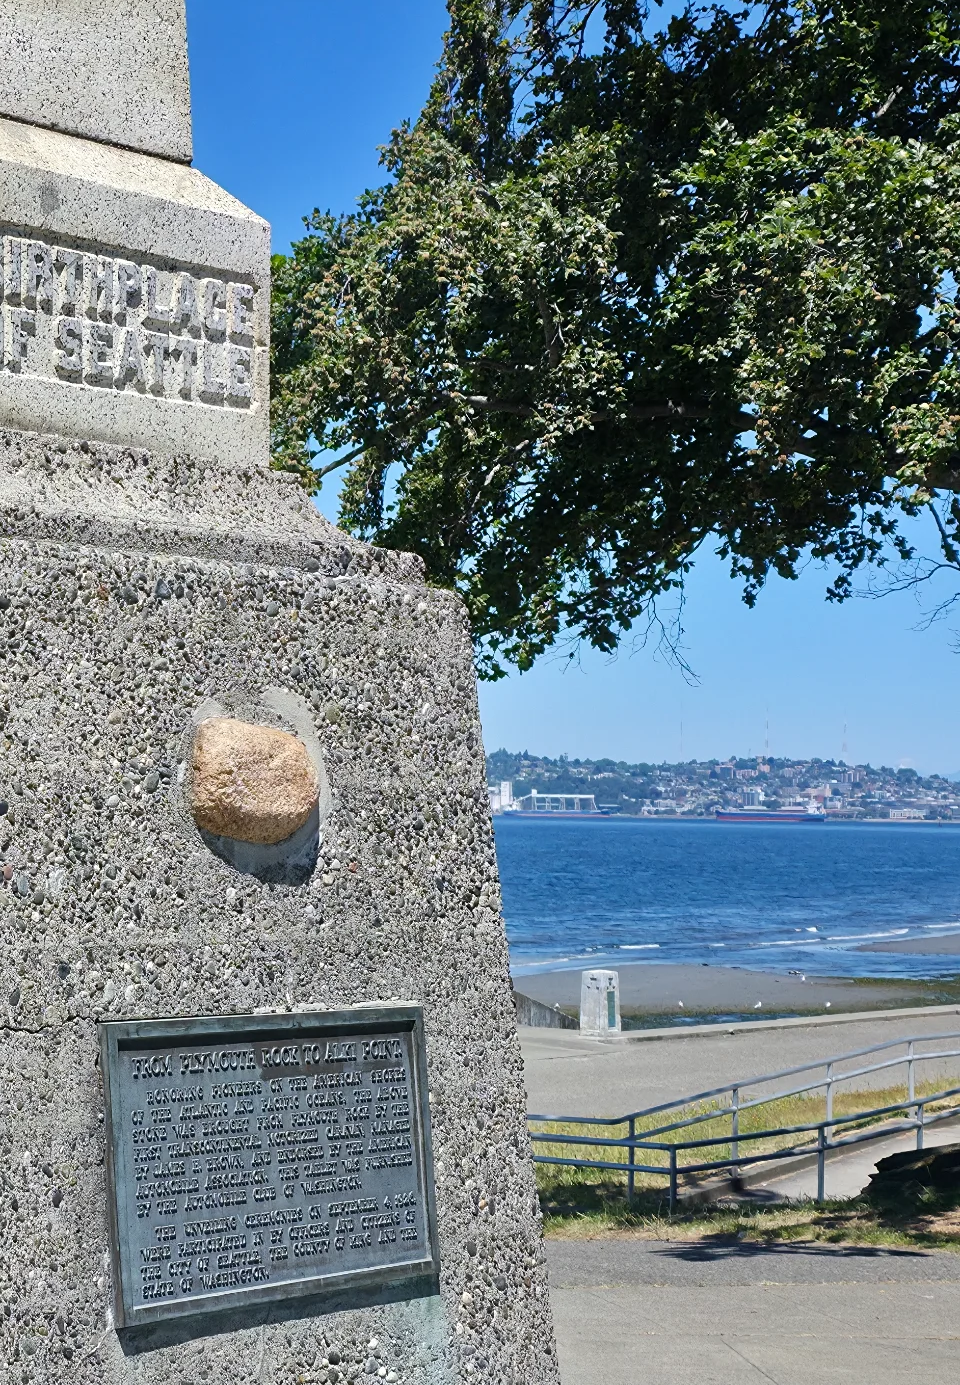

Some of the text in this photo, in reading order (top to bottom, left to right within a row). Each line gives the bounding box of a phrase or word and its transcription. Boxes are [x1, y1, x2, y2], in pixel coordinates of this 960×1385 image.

[53, 316, 255, 406] SEATTLE
[131, 1055, 173, 1078] FROM
[179, 1049, 256, 1074] PLYMOUTH
[260, 1046, 299, 1068] ROCK
[302, 1044, 320, 1065] TO
[322, 1041, 357, 1063] ALKI
[287, 1076, 307, 1092] THE
[150, 1106, 171, 1123] THE
